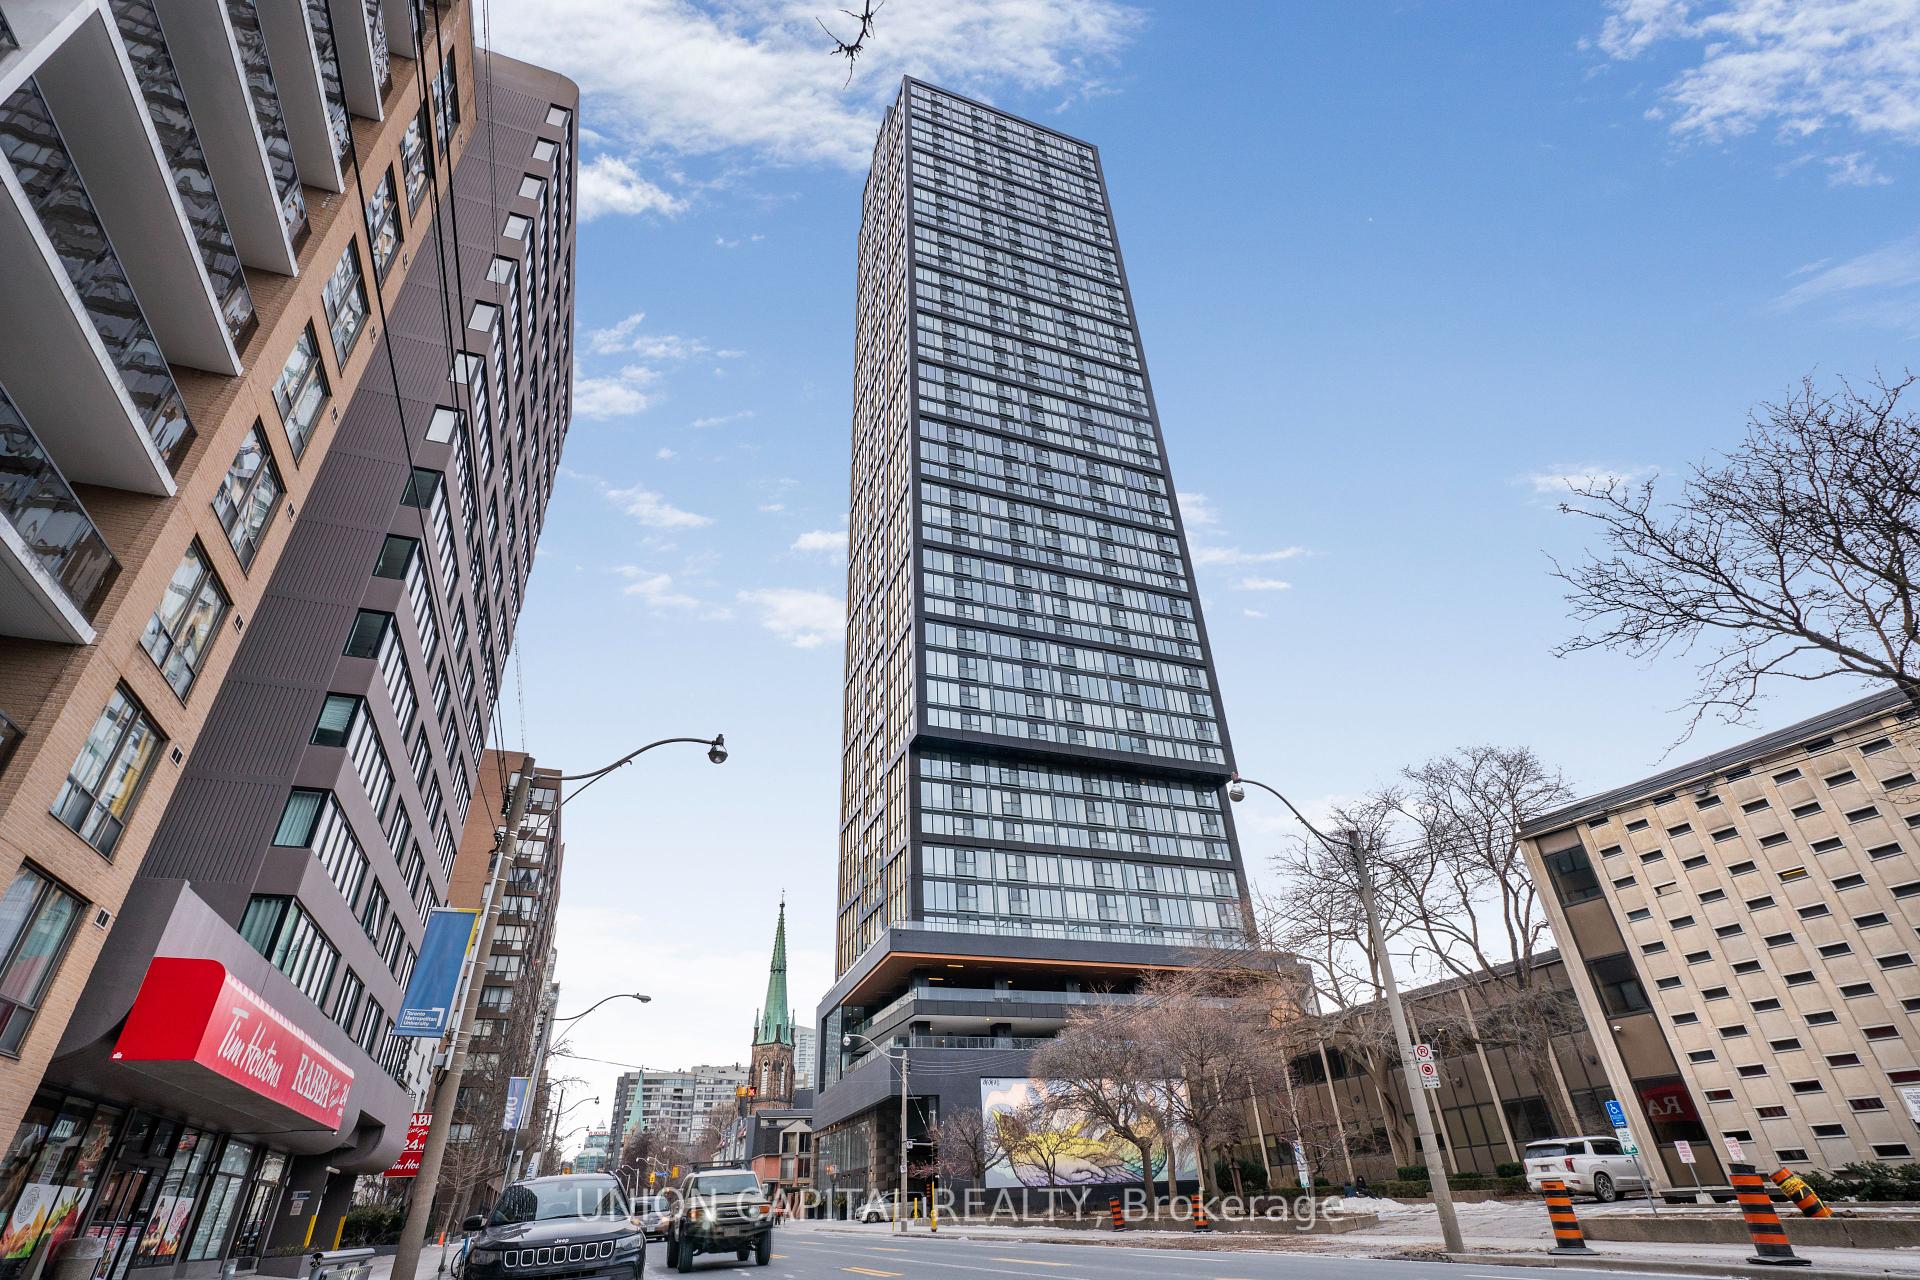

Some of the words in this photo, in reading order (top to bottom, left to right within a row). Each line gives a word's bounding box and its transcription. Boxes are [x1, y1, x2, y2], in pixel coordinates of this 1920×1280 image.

[217, 1007, 249, 1067] Tim
[239, 1020, 284, 1089] Hortons
[291, 1053, 334, 1109] RABBA
